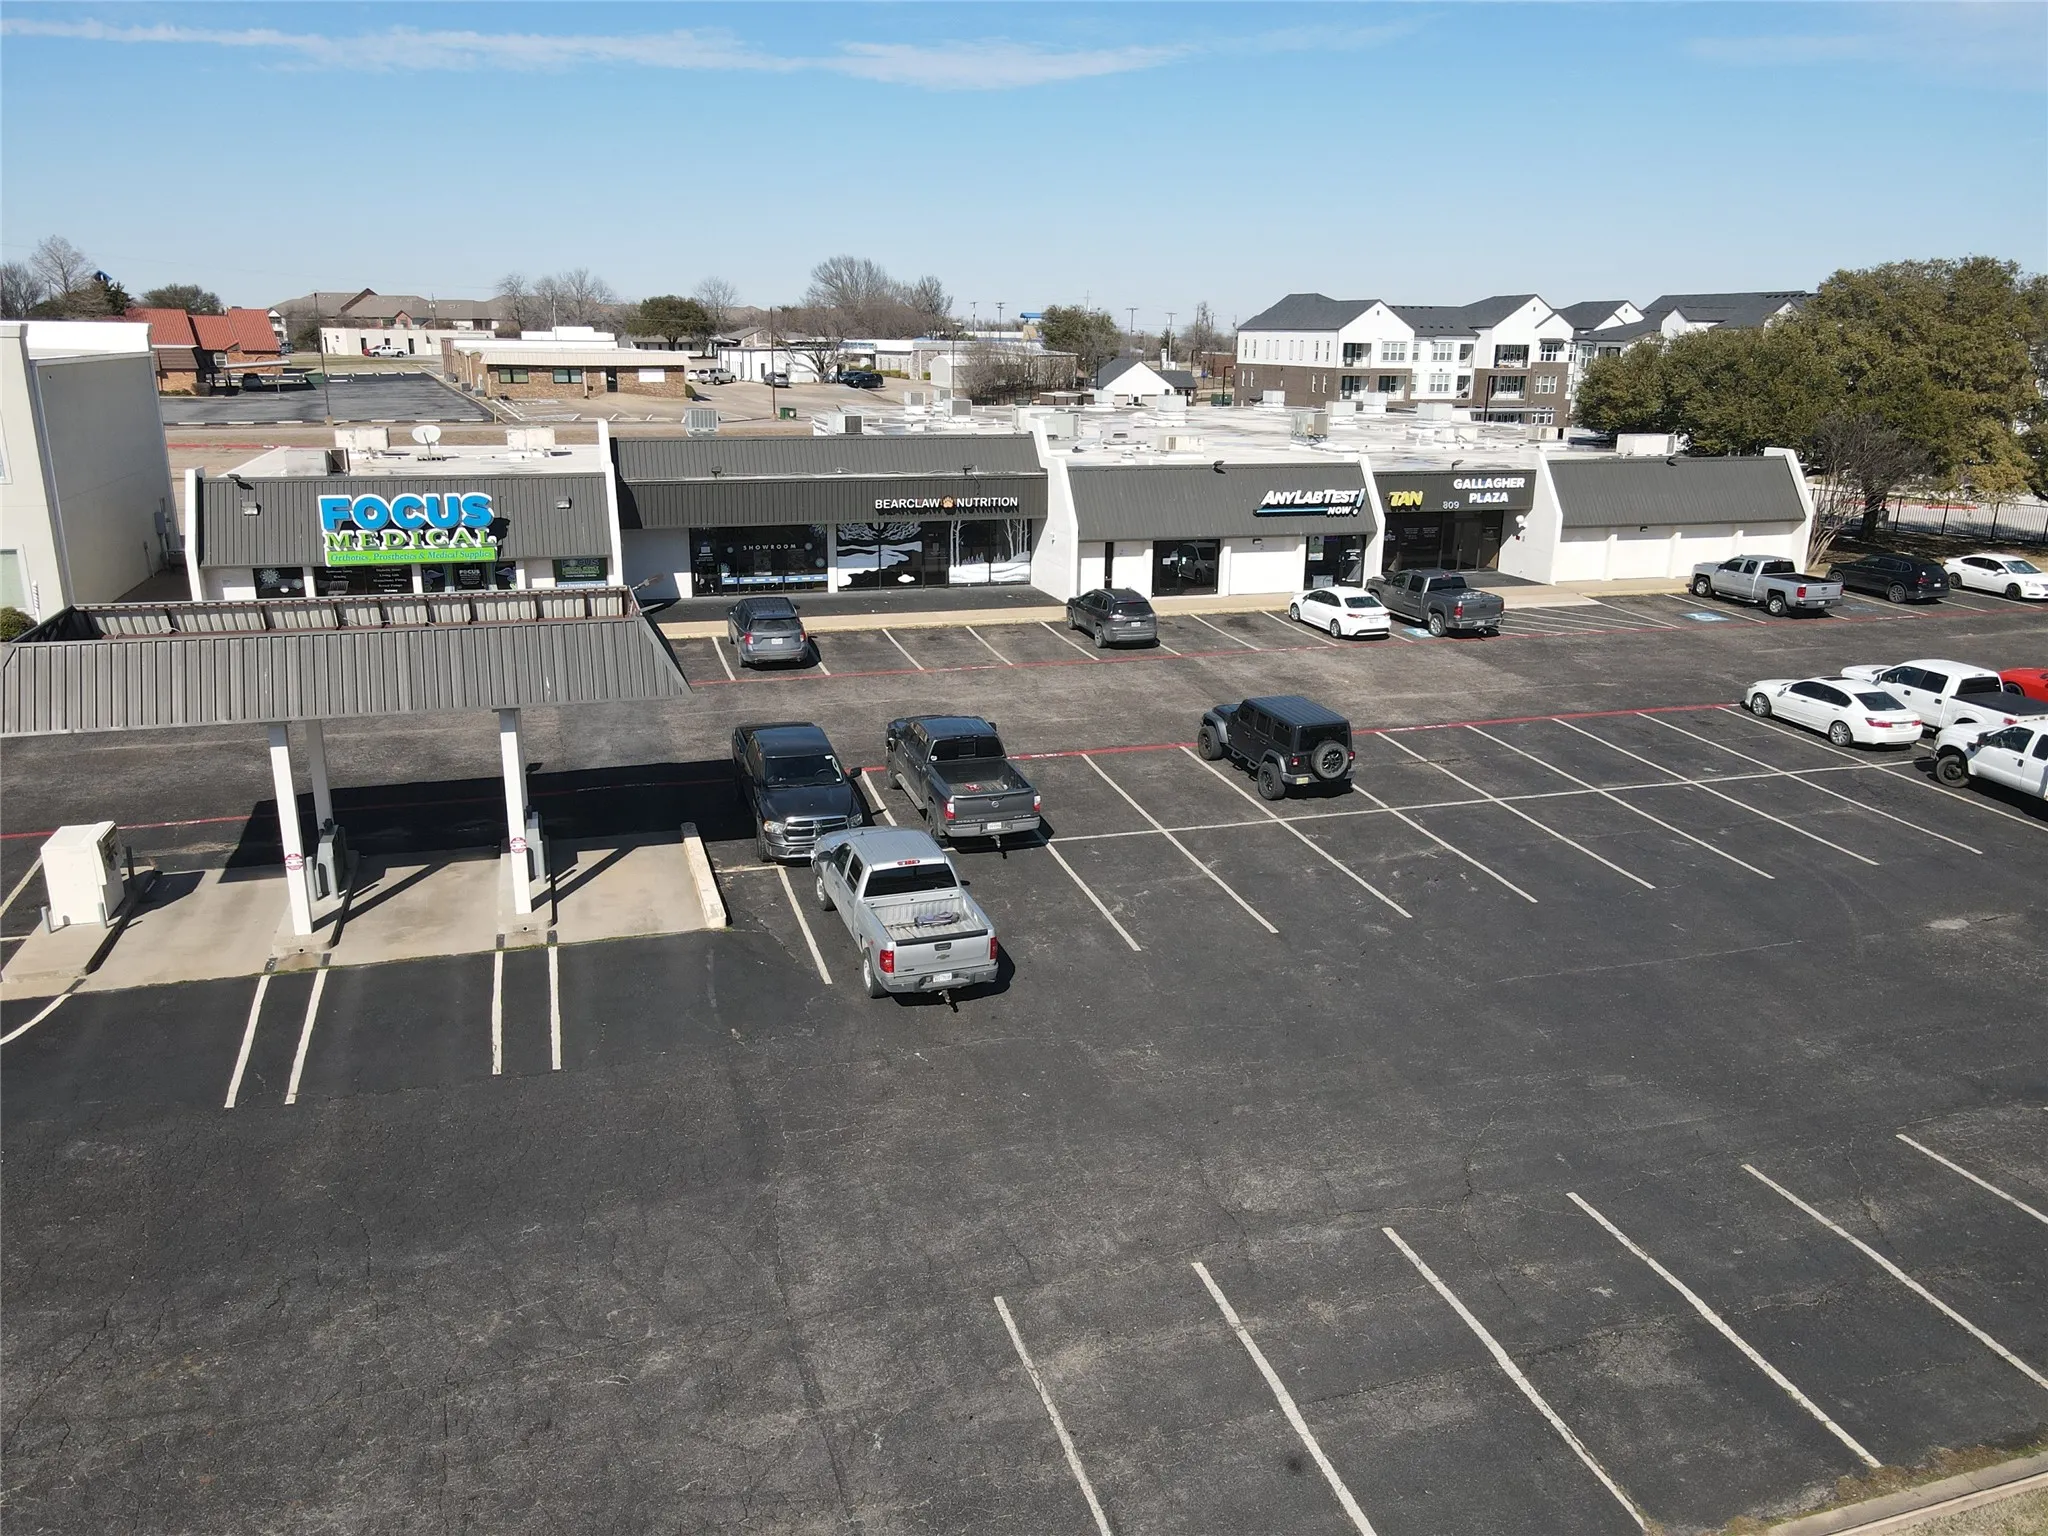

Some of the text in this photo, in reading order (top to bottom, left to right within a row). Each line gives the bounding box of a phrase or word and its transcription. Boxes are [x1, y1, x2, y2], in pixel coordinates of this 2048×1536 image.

[1453, 477, 1525, 490] GALLAGHER
[874, 496, 1018, 509] BEARCLAW NUTRITION
[1388, 490, 1424, 507] TAN
[1468, 492, 1509, 503] PLAZA
[318, 492, 495, 531] FOCUS
[1327, 506, 1352, 515] NOW
[1442, 501, 1460, 509] 809
[325, 529, 496, 549] MEDICAL
[743, 543, 797, 551] SHOWROOM
[330, 549, 492, 563] Orthotics, Prosthetics & Medical Supplies
